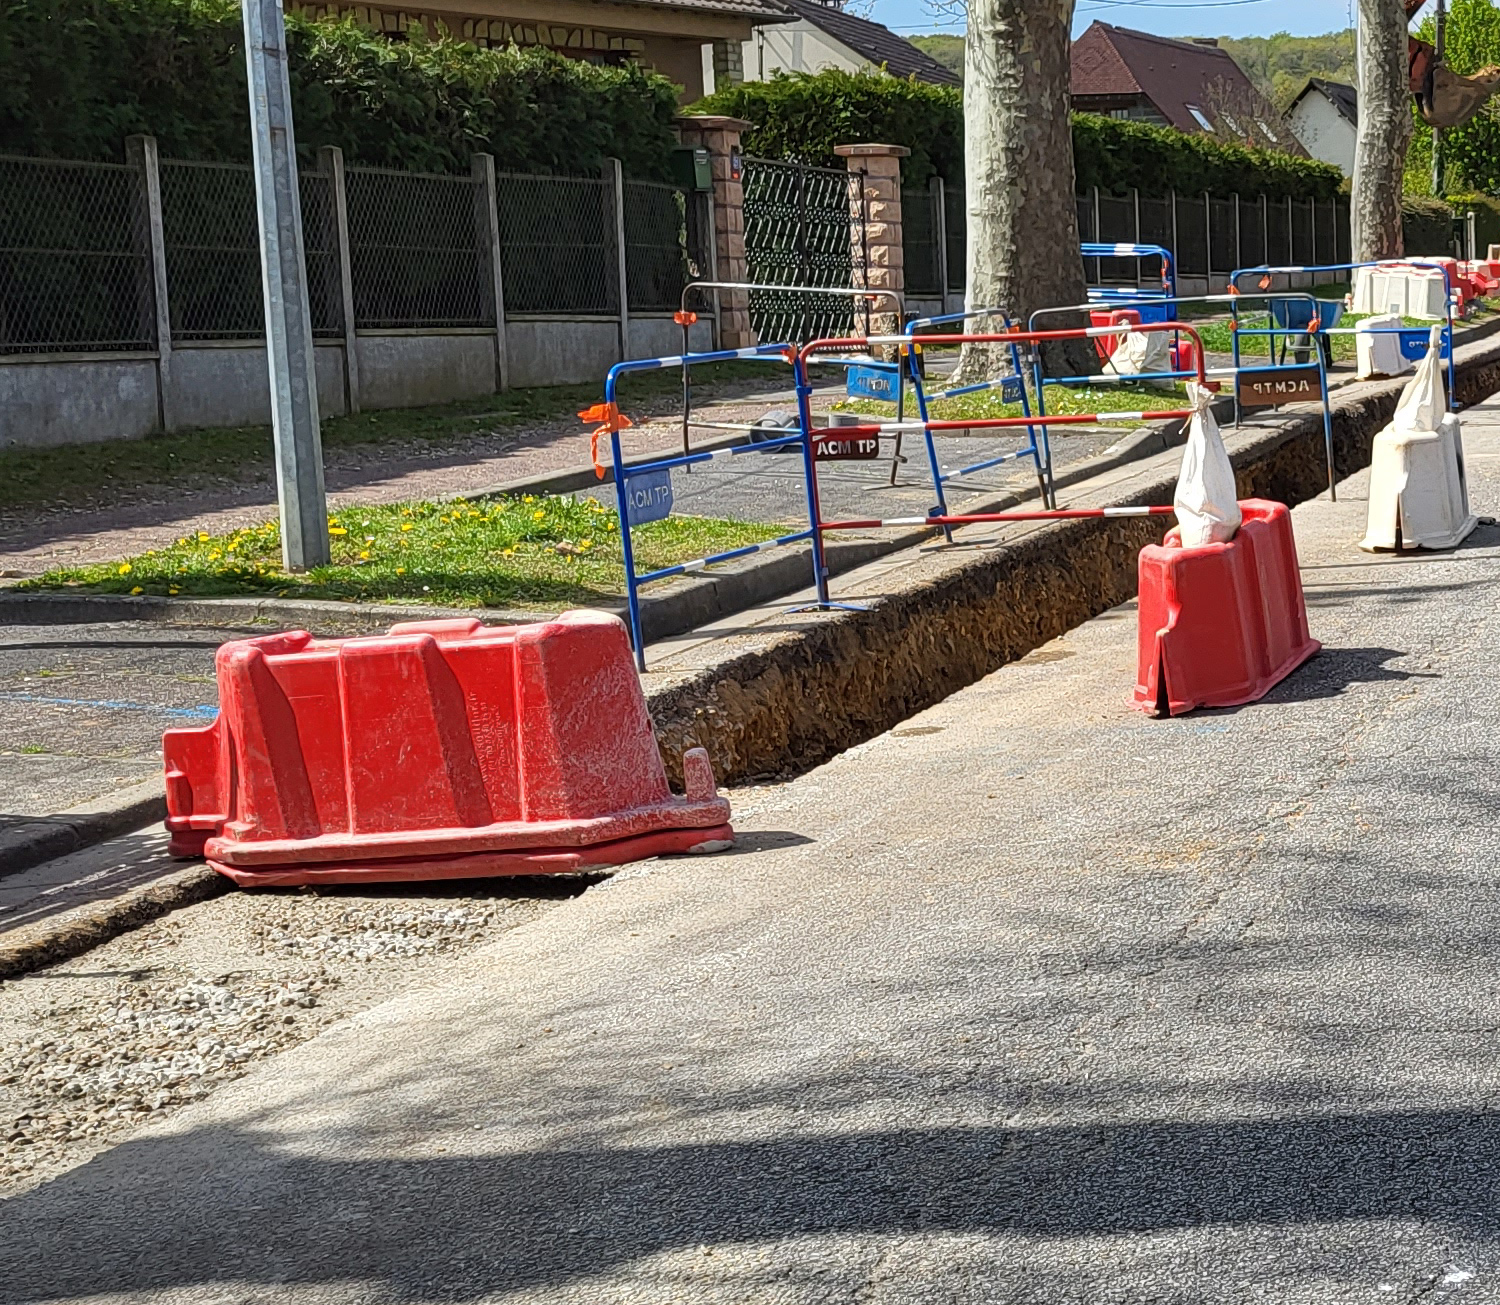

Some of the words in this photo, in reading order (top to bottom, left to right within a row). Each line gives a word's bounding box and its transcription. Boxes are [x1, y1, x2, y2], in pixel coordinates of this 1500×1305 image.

[817, 440, 851, 456] ACM
[857, 439, 876, 454] TP
[628, 488, 653, 510] ACM
[655, 485, 669, 504] TP
